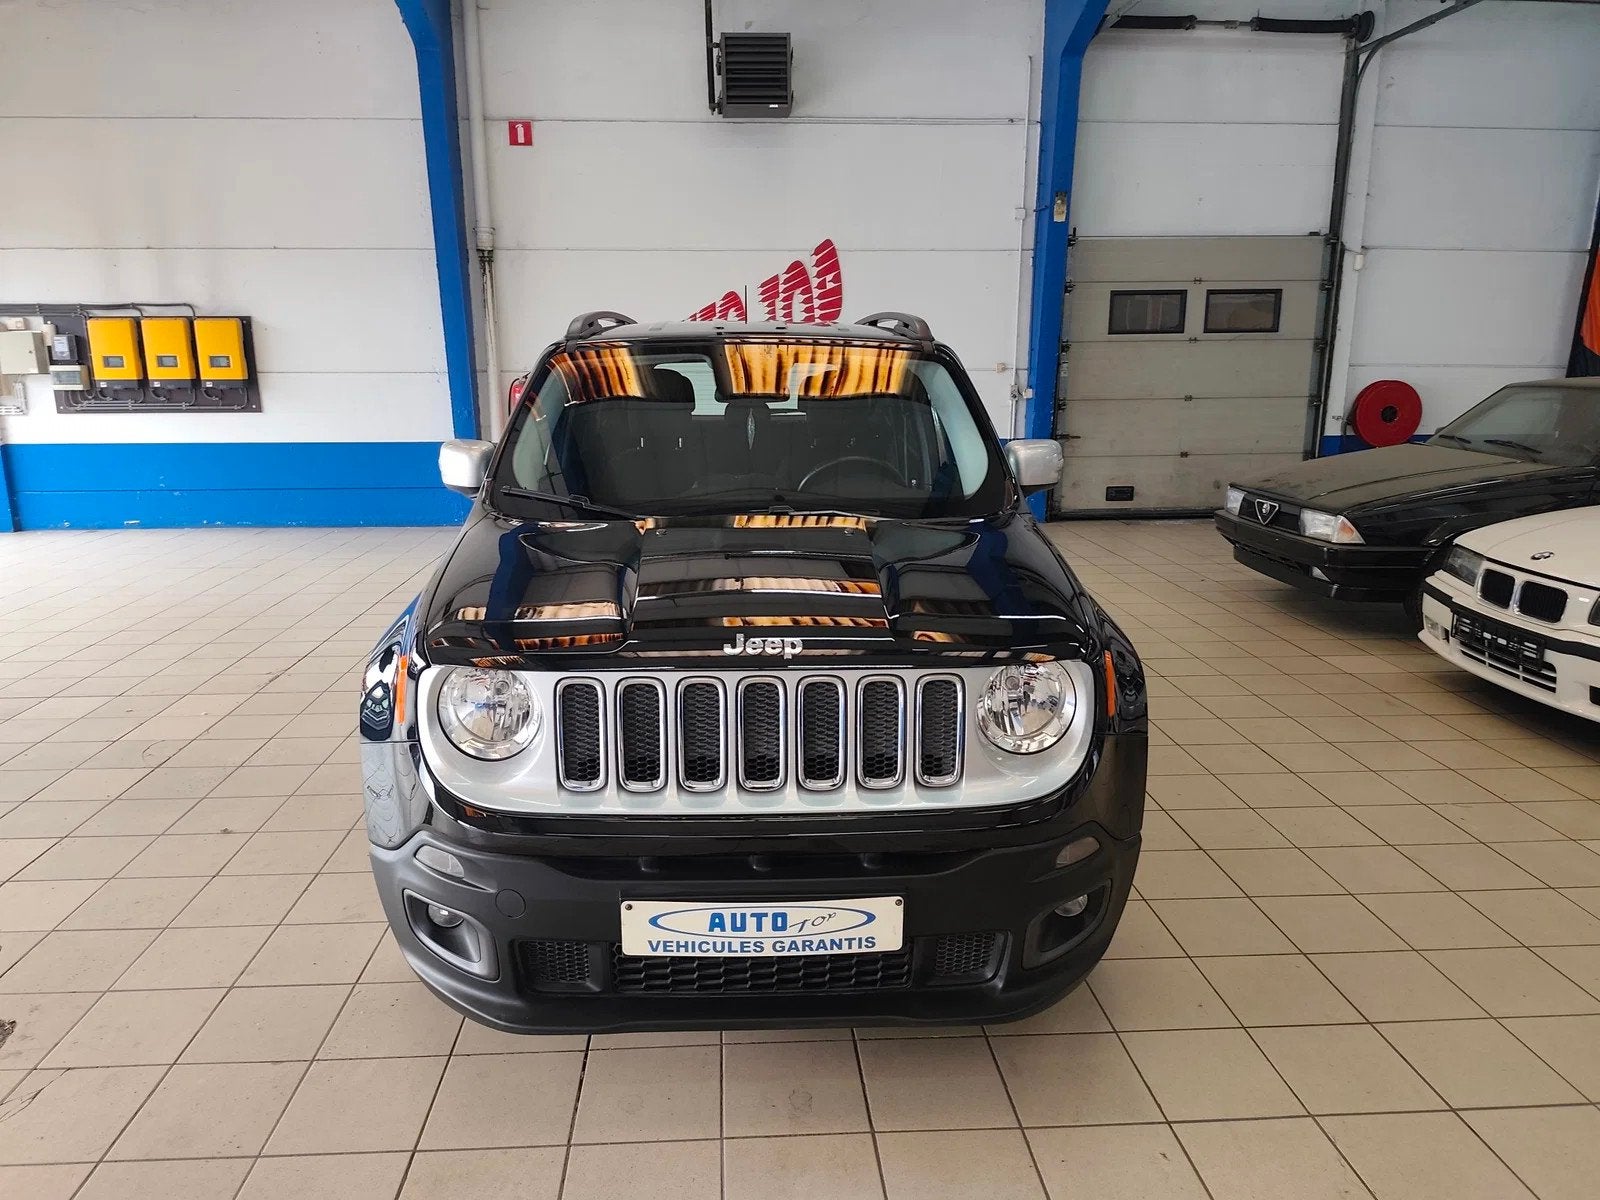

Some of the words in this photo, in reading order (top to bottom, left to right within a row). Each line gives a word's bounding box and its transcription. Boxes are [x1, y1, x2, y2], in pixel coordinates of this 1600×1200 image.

[723, 633, 803, 659] Jeep
[708, 912, 788, 932] AUTO
[647, 940, 765, 953] VEHICULES
[771, 936, 876, 952] GARANTIS
